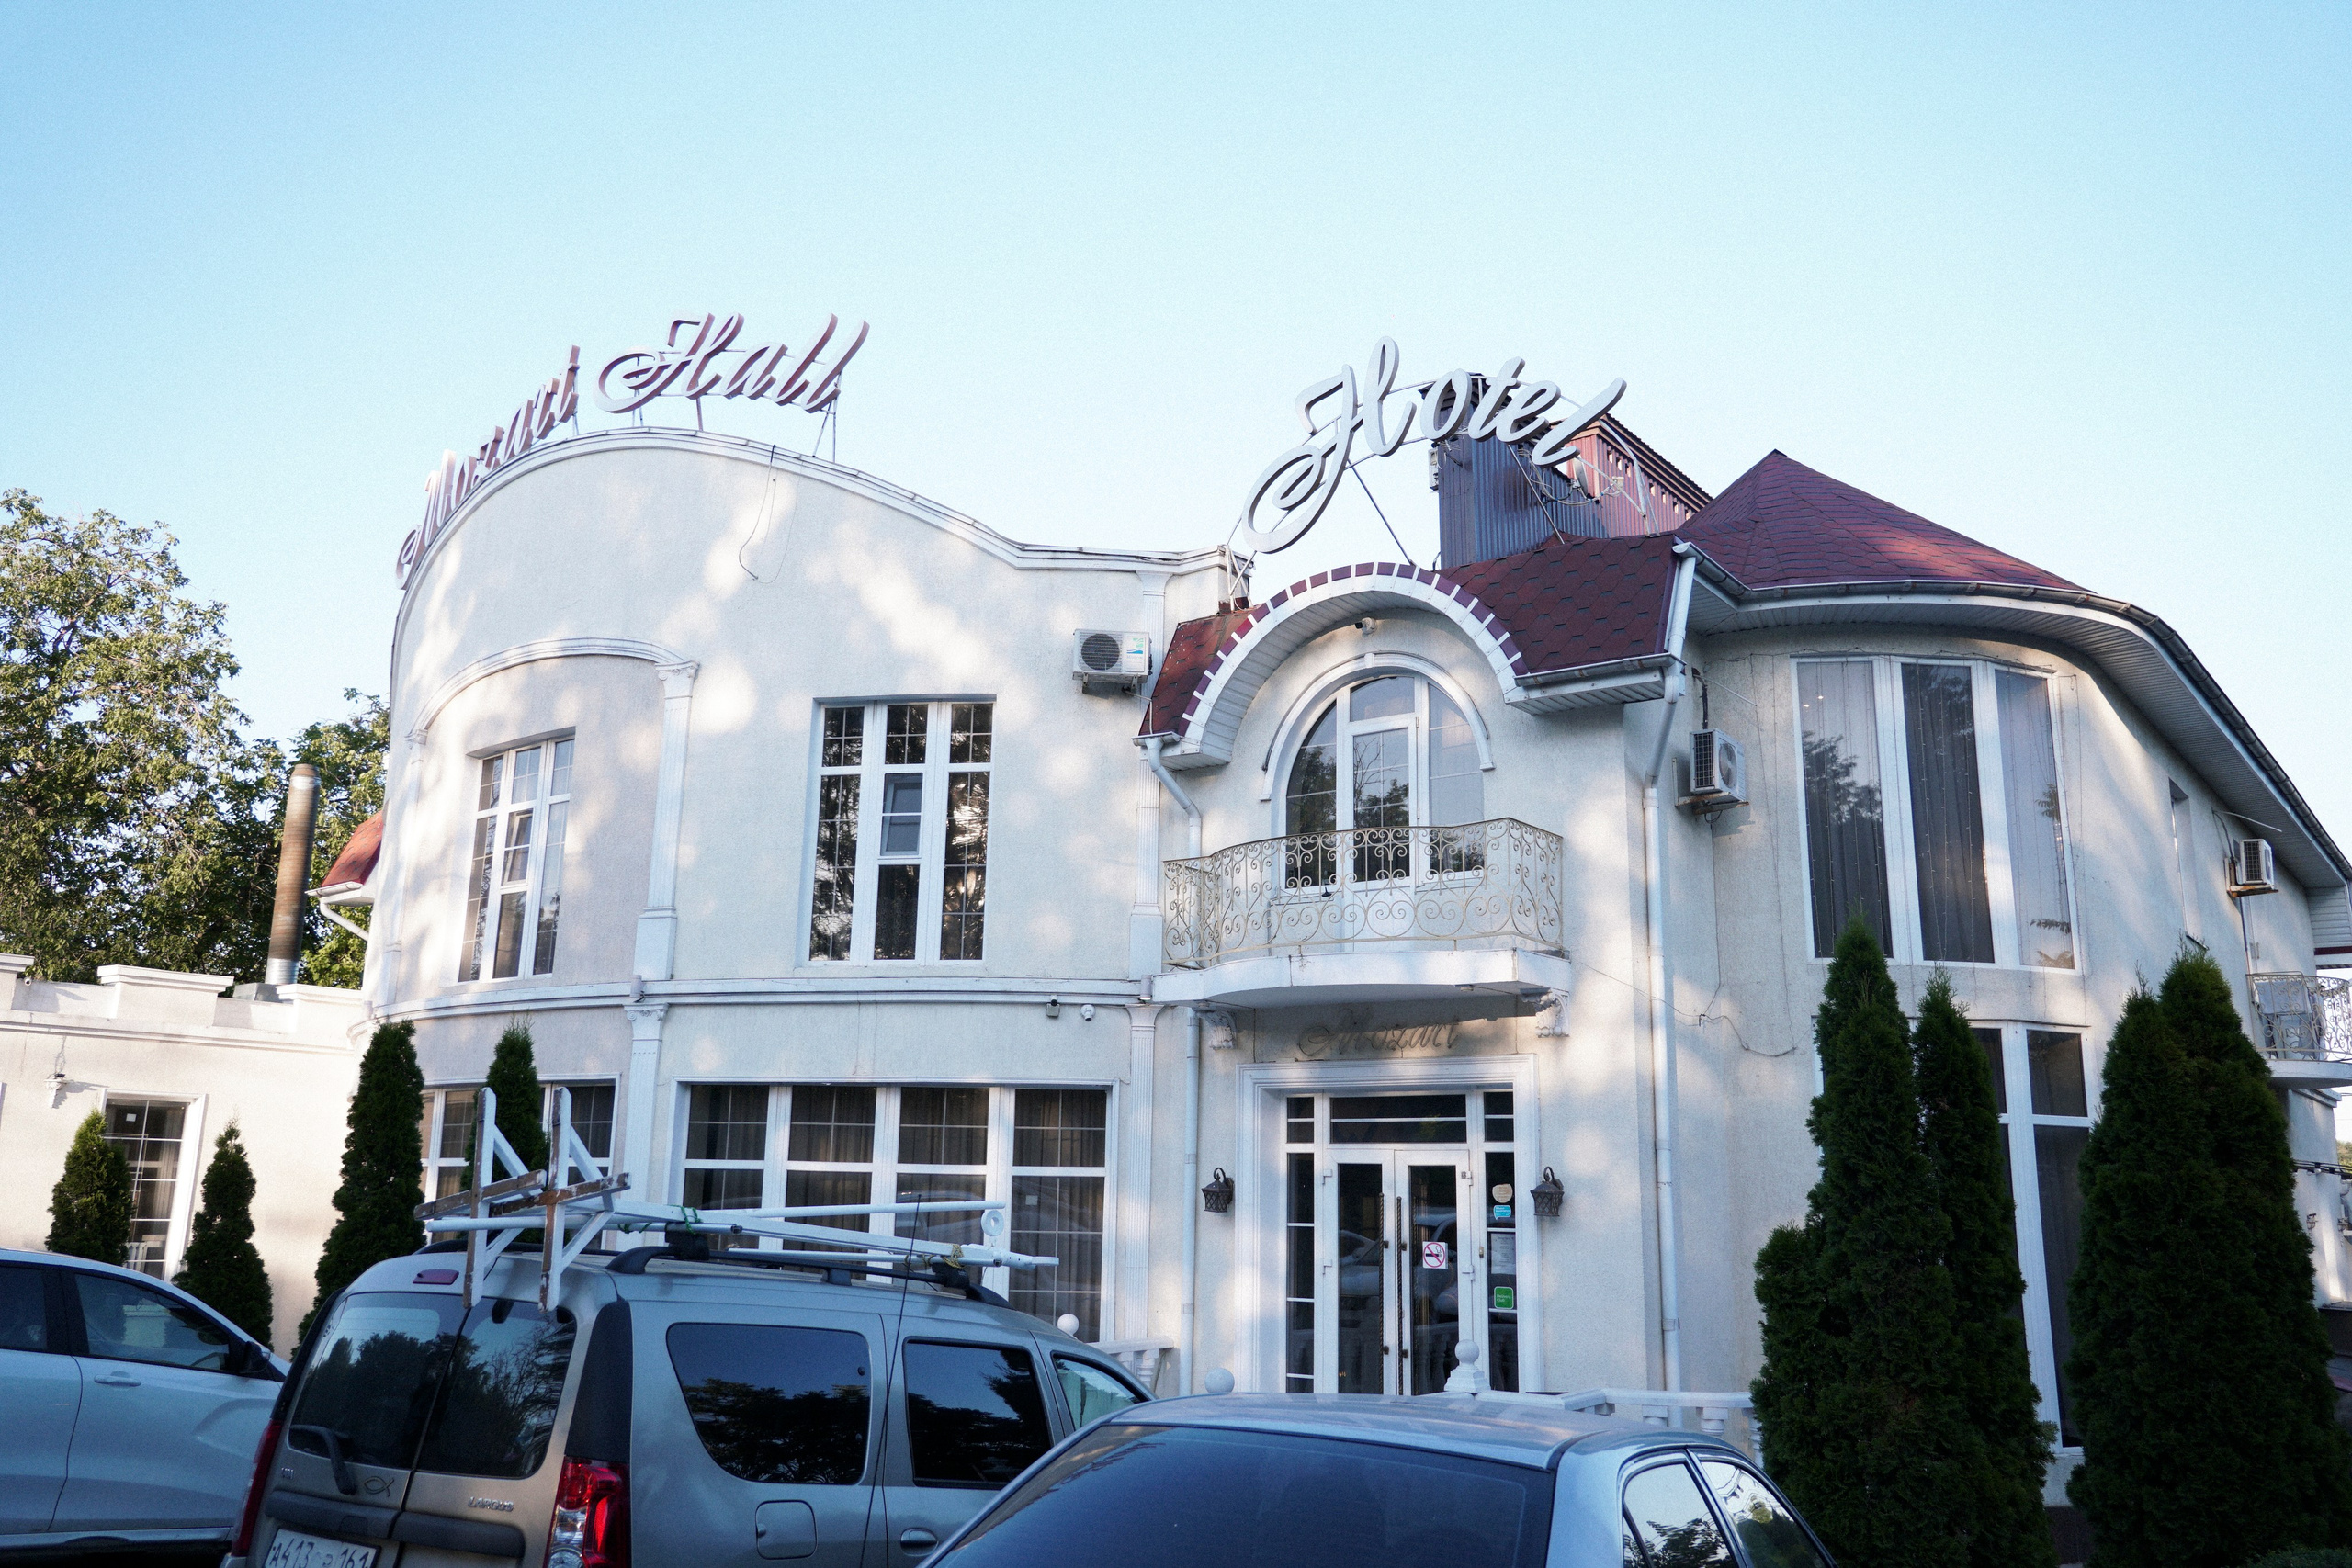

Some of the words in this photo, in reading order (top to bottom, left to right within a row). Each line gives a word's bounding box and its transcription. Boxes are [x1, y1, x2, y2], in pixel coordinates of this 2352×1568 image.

[593, 312, 870, 414] Hall
[1242, 335, 1627, 554] Hotel
[468, 1496, 514, 1512] LARGUS
